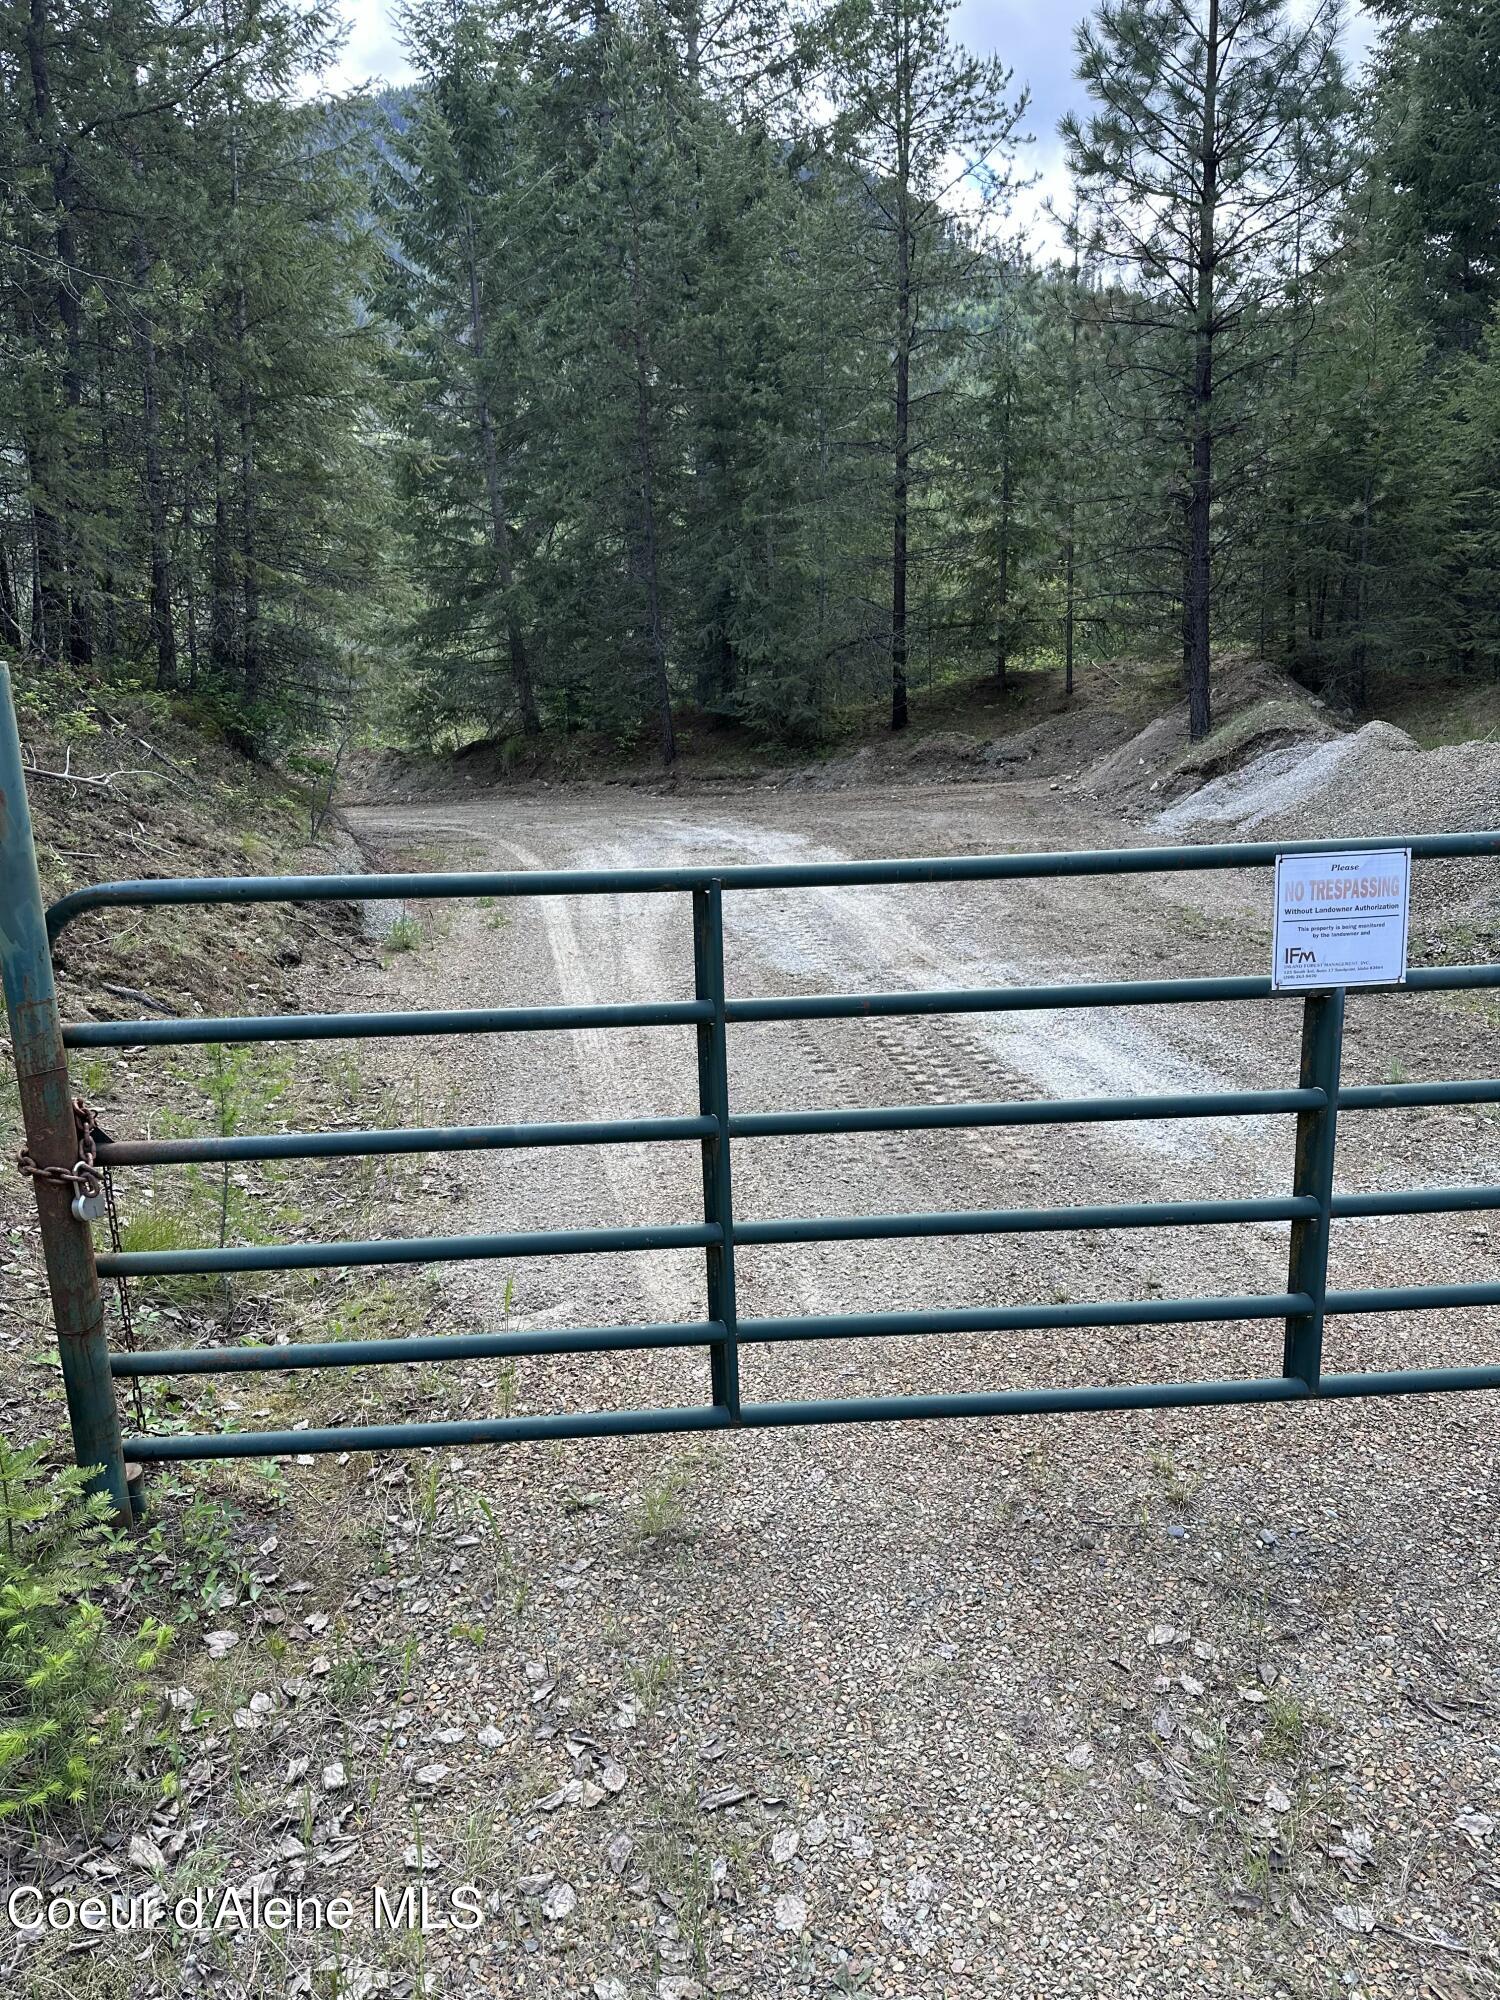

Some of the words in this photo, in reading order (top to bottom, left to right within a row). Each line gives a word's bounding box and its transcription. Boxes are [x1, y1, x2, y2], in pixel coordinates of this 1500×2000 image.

[1285, 880, 1305, 902] NO
[1309, 875, 1399, 901] TRESPASSING
[1284, 907, 1313, 915] Without
[1315, 905, 1352, 913] Landowner
[1355, 903, 1399, 911] Authorization
[1342, 923, 1357, 931] being
